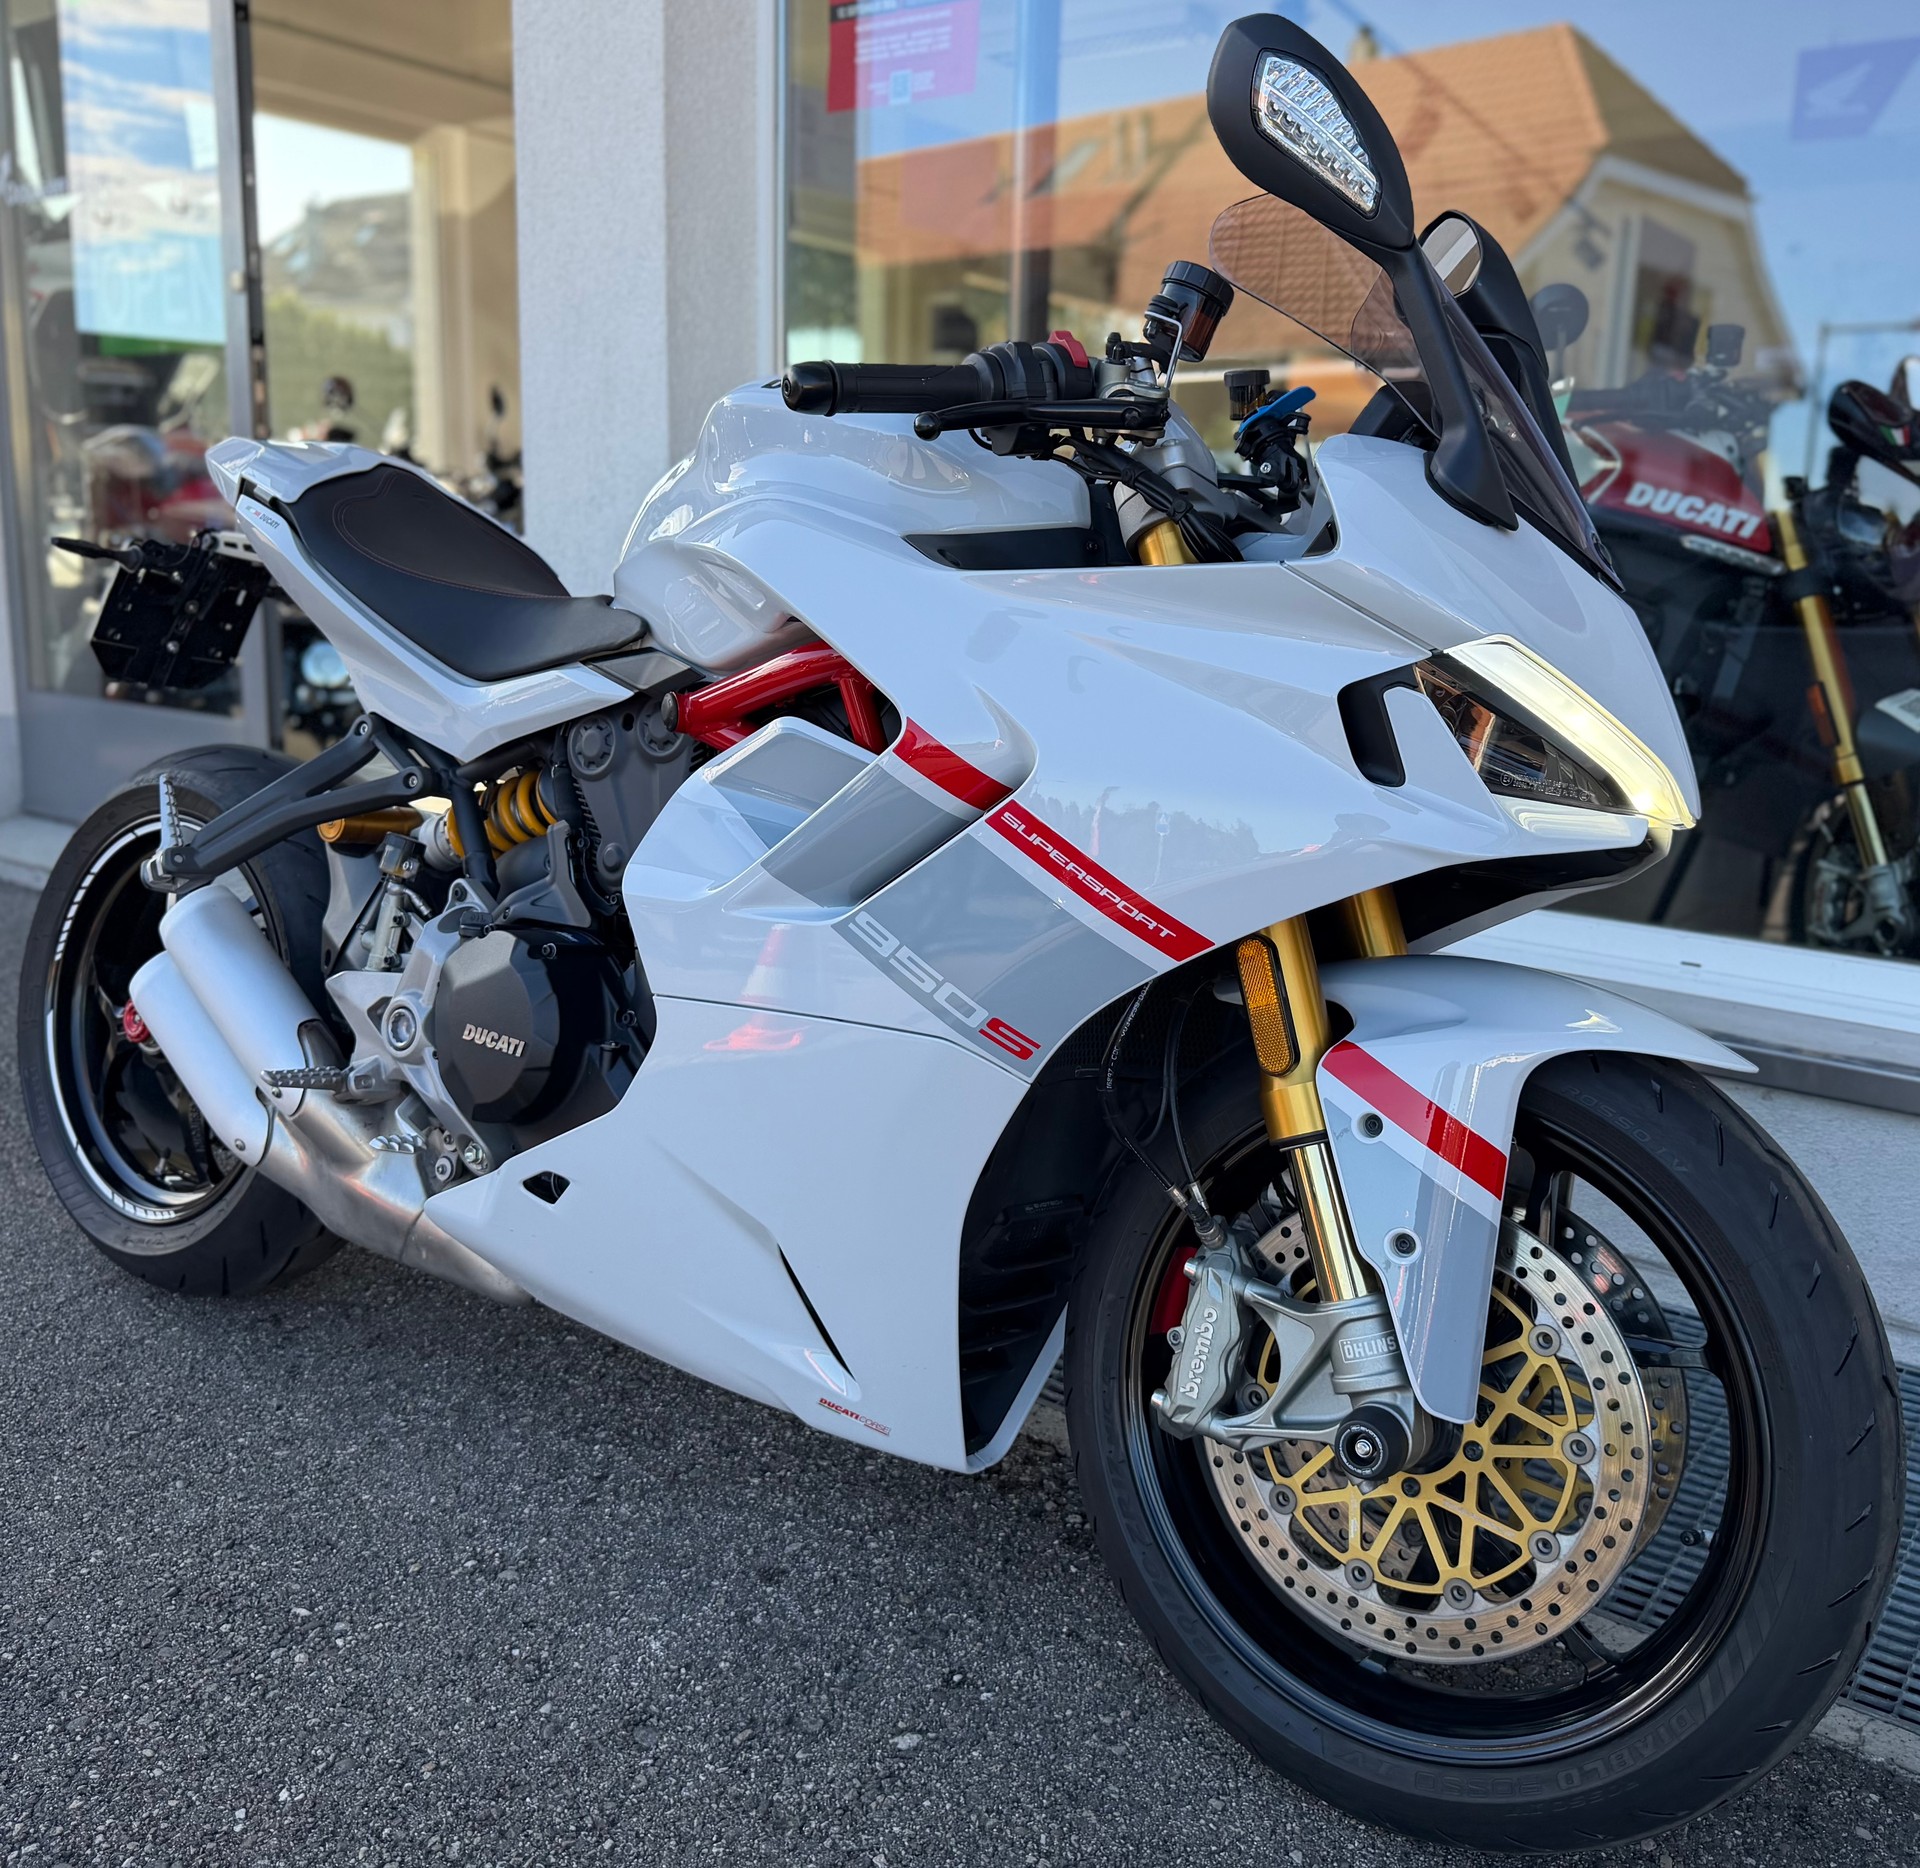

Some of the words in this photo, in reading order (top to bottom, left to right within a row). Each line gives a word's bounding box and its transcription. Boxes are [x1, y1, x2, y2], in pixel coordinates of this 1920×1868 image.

[260, 513, 280, 529] DUCATI
[1625, 481, 1761, 539] DUCATI
[1000, 811, 1177, 938] SUPERSPORT
[462, 1023, 525, 1057] DUCATI
[1560, 1085, 1652, 1142] ROSSO
[1180, 1306, 1218, 1399] brembo
[1343, 1335, 1397, 1359] ÖHLINS
[819, 1397, 860, 1420] DUCATI
[1552, 1705, 1699, 1791] DIABLO
